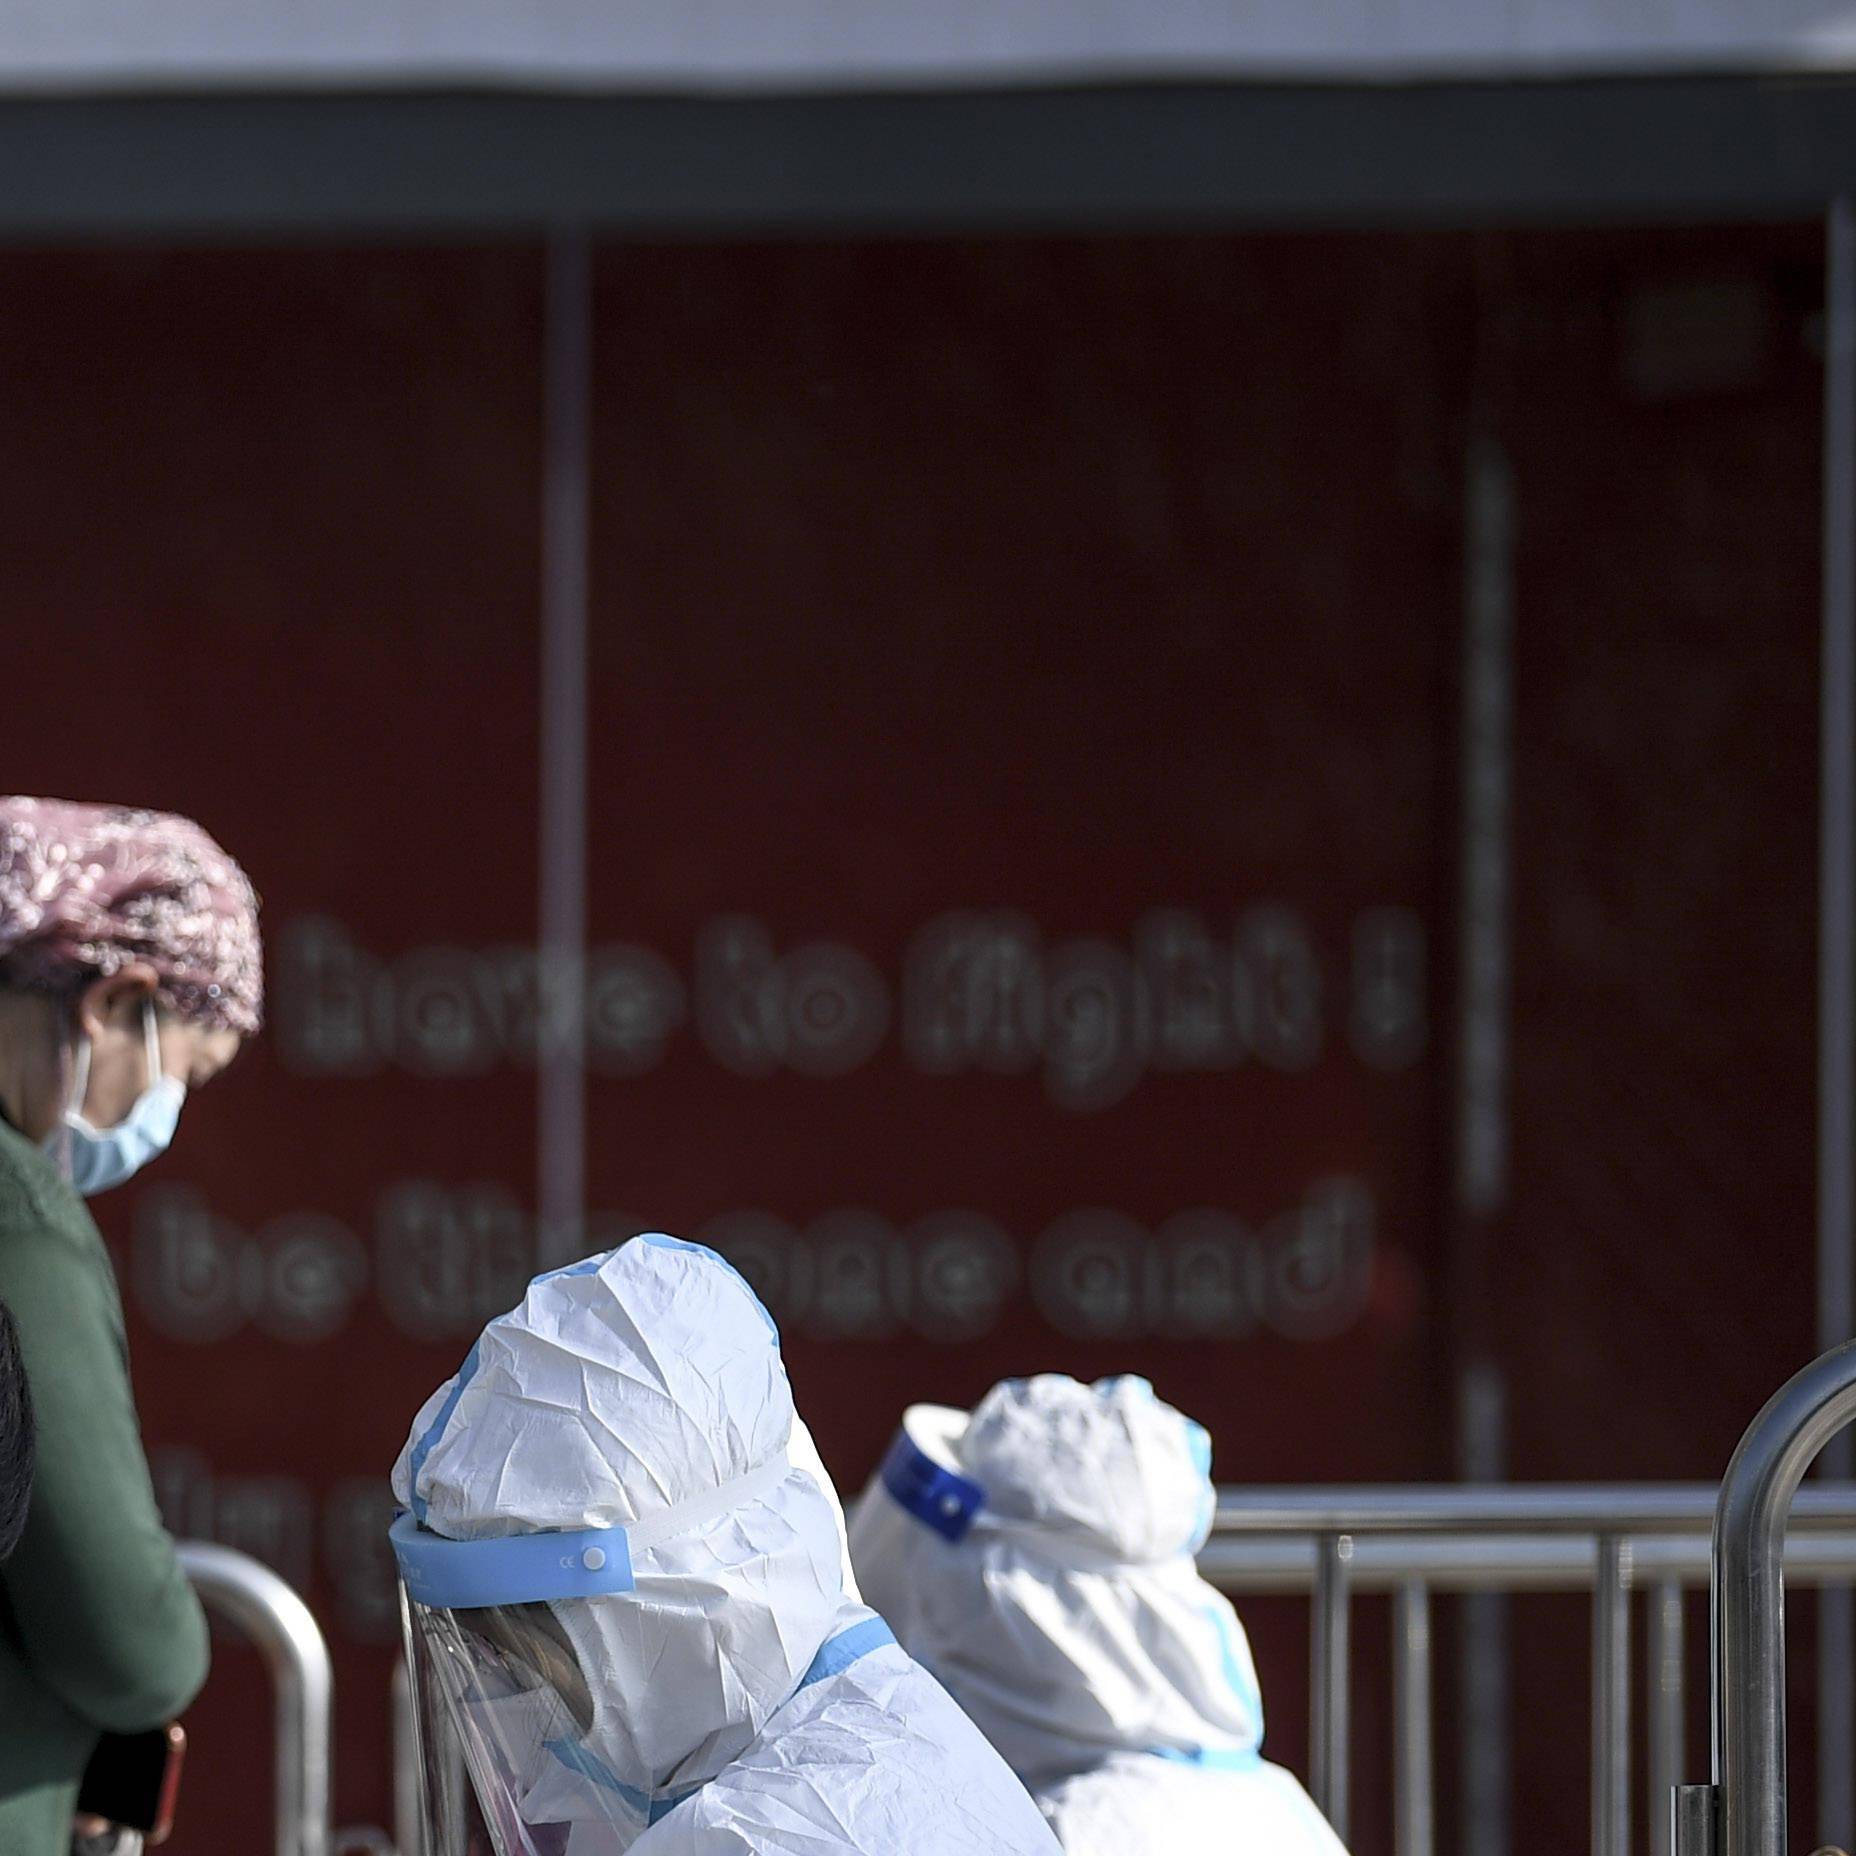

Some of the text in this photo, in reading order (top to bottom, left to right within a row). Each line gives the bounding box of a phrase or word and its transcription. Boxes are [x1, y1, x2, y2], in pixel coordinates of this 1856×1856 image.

[278, 912, 685, 1076] have
[692, 910, 890, 1076] to
[902, 902, 1324, 1114] fight
[132, 1182, 366, 1342] be
[1031, 1172, 1377, 1342] and
